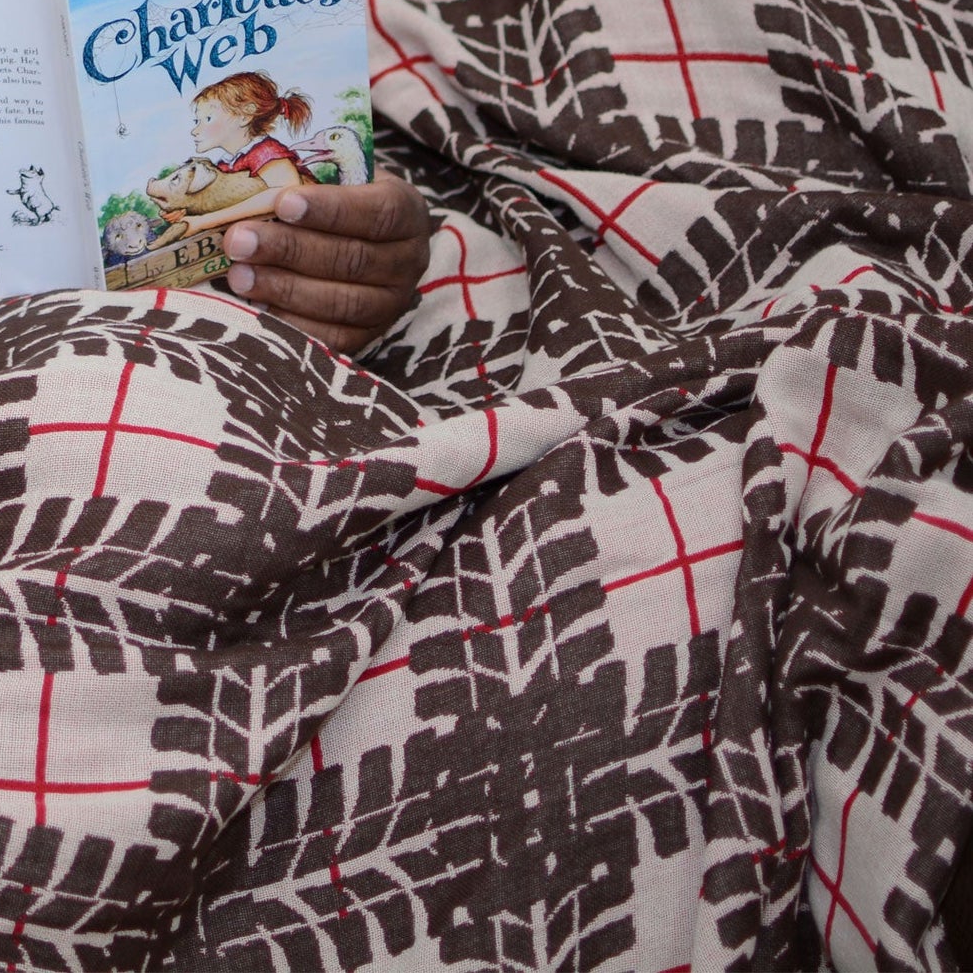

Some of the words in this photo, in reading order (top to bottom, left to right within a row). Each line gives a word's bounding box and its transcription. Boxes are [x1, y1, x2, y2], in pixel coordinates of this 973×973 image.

[23, 48, 39, 56] girl
[151, 11, 277, 96] Web
[0, 56, 17, 65] pig.
[21, 56, 40, 66] He's
[2, 76, 20, 84] also
[22, 77, 42, 85] lives
